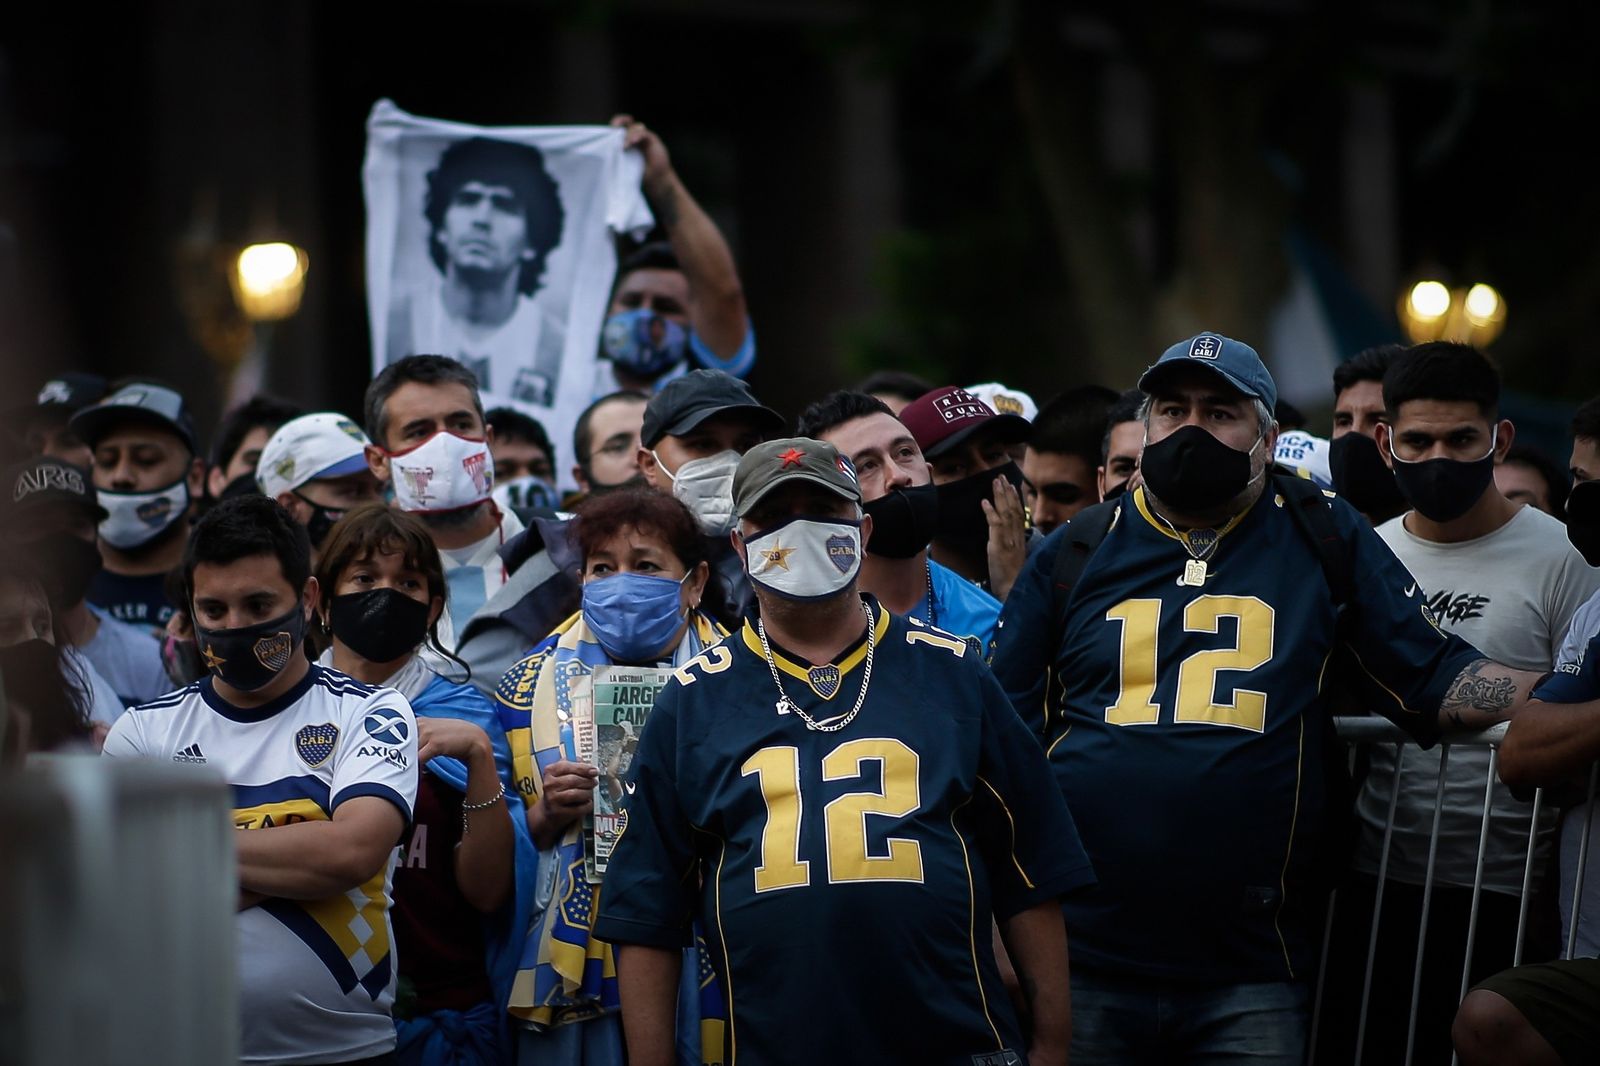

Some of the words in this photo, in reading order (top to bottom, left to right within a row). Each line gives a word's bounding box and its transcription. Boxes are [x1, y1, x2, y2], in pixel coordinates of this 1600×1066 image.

[942, 393, 974, 407] RIP
[1104, 594, 1276, 733] 12
[299, 733, 333, 747] CABJ
[356, 745, 408, 767] AXION
[741, 738, 924, 893] 12
